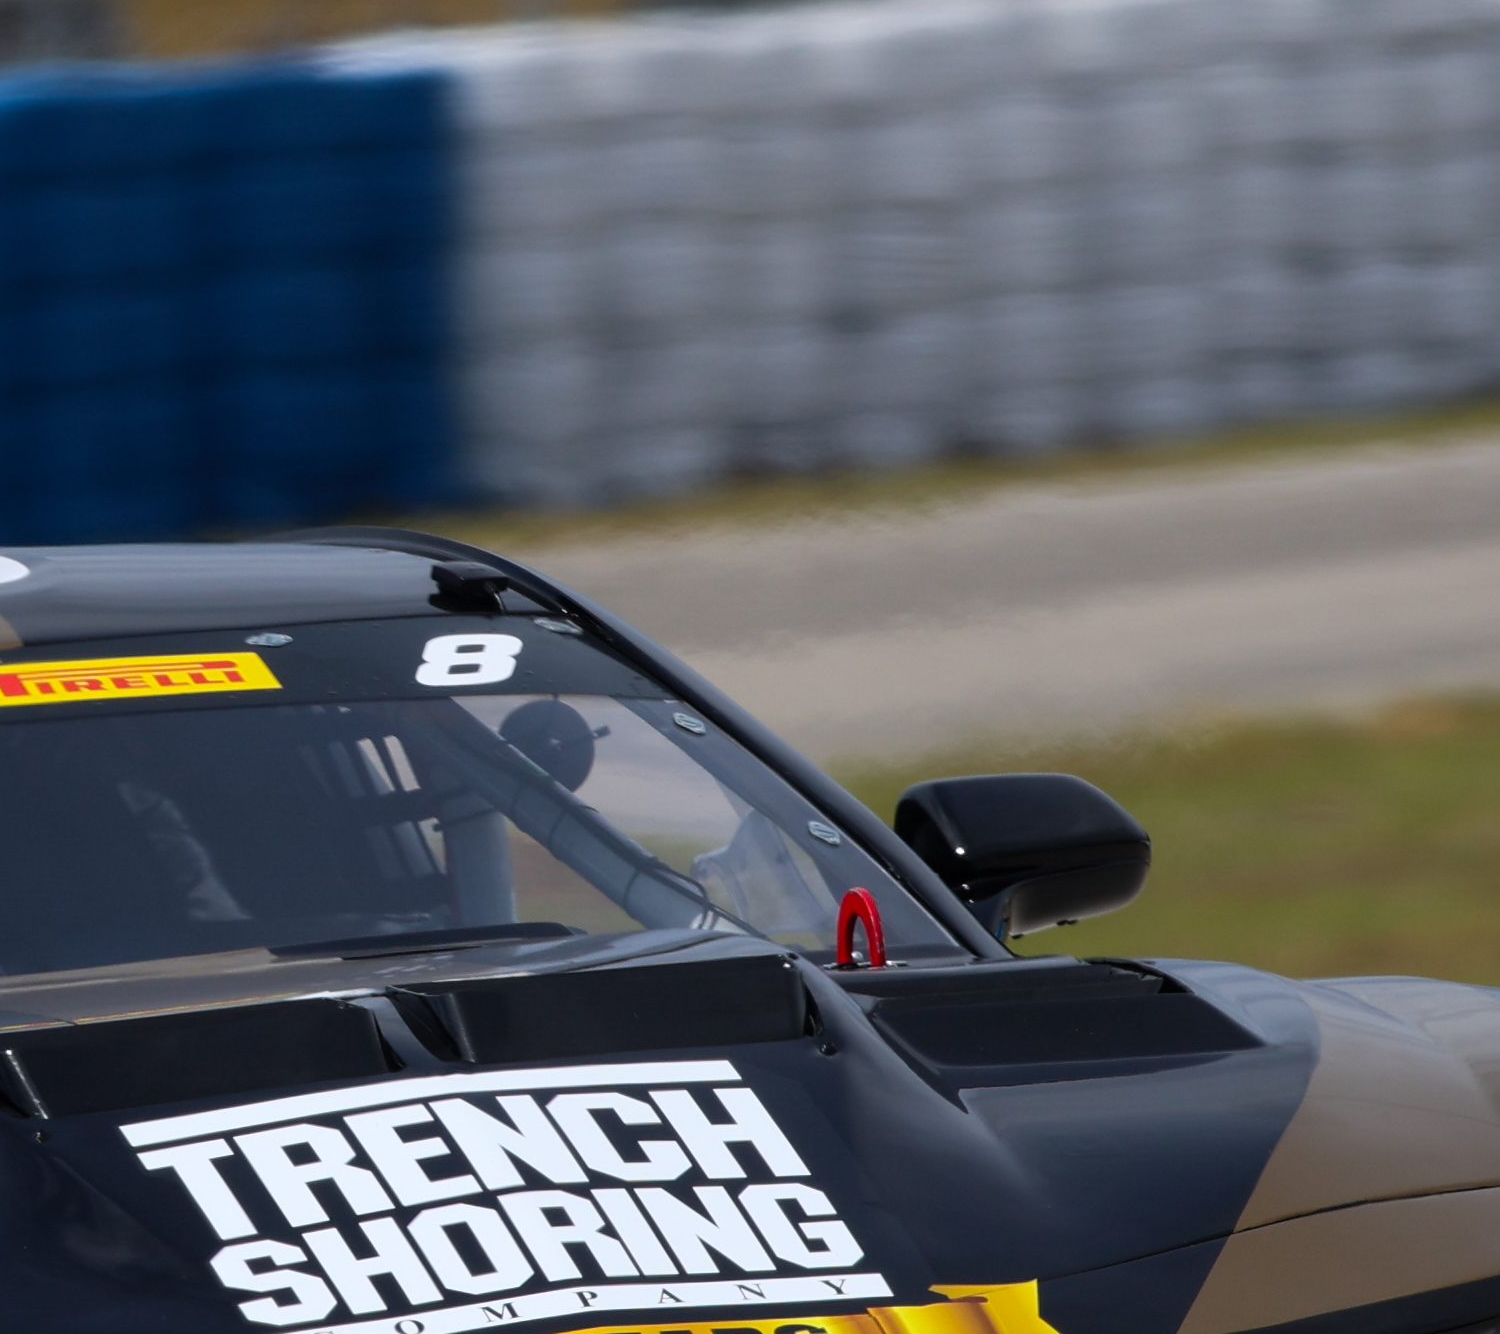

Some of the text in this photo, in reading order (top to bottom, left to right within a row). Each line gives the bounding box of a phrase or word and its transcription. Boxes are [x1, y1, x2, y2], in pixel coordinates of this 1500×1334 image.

[415, 633, 523, 686] 8
[137, 1086, 812, 1242] TRENCH
[209, 1181, 865, 1328] SHORING
